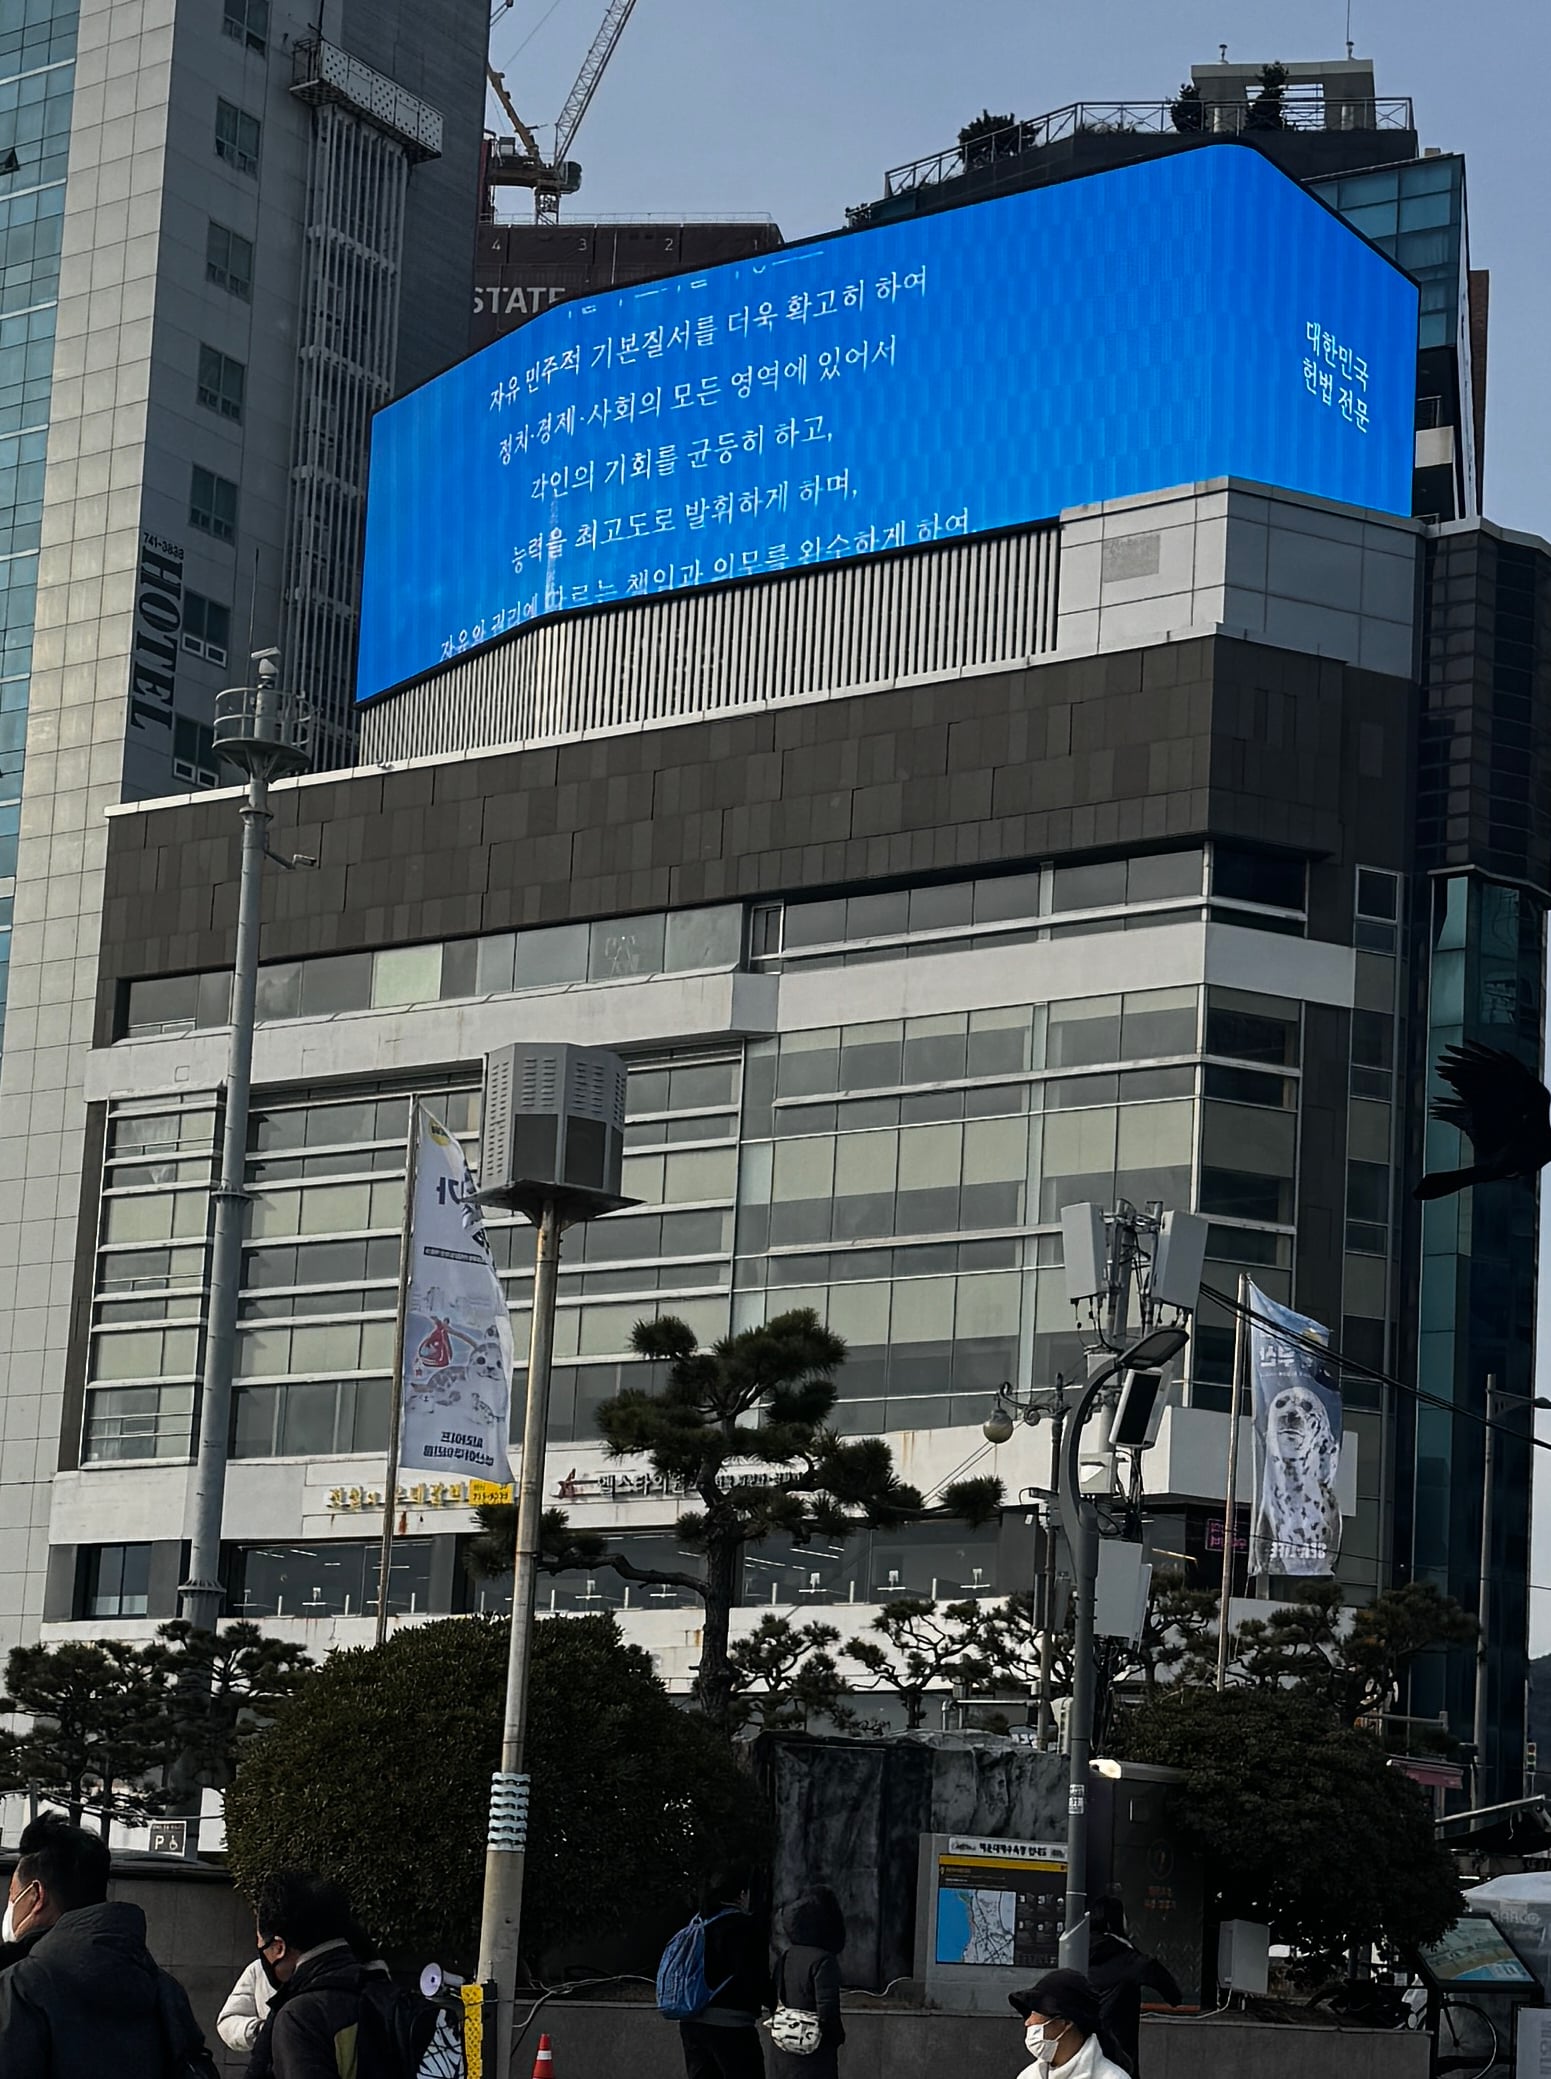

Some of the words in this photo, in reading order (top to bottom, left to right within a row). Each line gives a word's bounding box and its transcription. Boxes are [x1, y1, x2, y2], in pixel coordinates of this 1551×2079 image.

[491, 238, 502, 251] 4
[578, 238, 588, 251] 3
[664, 238, 674, 251] 2
[489, 375, 521, 413] 자유
[525, 344, 581, 393] 민주적
[590, 315, 718, 369] 기본질서를
[727, 301, 779, 339] 더욱
[785, 279, 864, 325] 확고히
[875, 264, 927, 304] 하여
[669, 375, 722, 410] 모든
[731, 353, 807, 398] 영역에
[818, 334, 896, 382] 있어서
[1306, 321, 1370, 393] 대한민국
[1302, 356, 1333, 407] 헌법
[1337, 386, 1371, 434] 전문
[530, 460, 595, 503] 각인의
[604, 444, 679, 486] 기회를
[687, 424, 764, 469] 균등히
[774, 415, 833, 449] 하고,
[511, 526, 568, 574] 능력을
[574, 507, 677, 552] 최고도로
[685, 480, 789, 530] 발휘하게
[798, 468, 858, 506] 하며,
[130, 545, 184, 731] HOTEL
[154, 1834, 165, 1850] P
